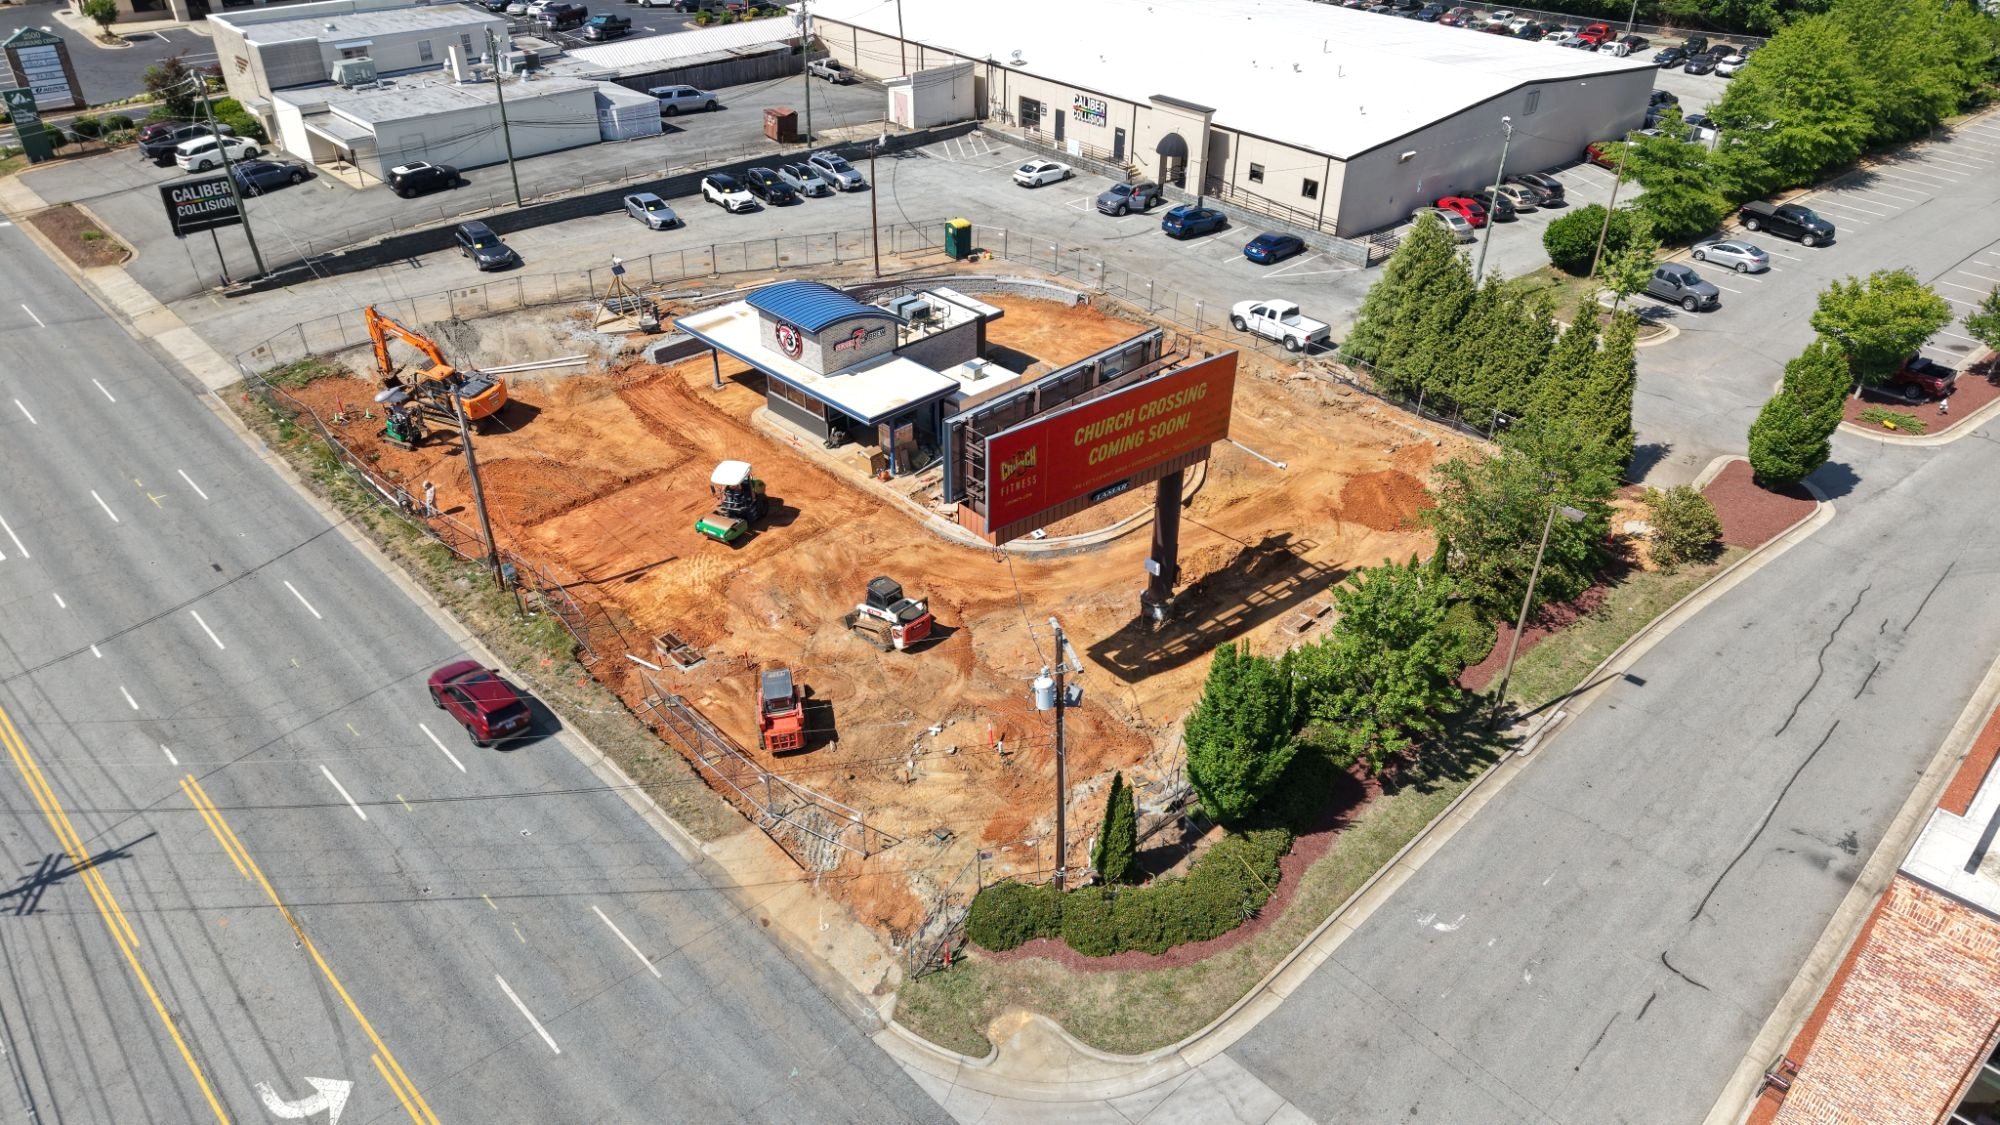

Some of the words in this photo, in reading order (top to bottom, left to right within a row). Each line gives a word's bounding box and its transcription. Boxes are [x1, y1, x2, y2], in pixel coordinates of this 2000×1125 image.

[1072, 94, 1107, 113] CALIBER
[1072, 109, 1106, 128] COLLISION
[171, 181, 232, 203] CALIBER
[177, 196, 237, 217] COLLISION
[868, 327, 886, 341] BREW
[1074, 408, 1136, 447] CHURCH
[1138, 382, 1208, 423] CROSSING
[1088, 430, 1145, 466] COMING
[1148, 411, 1192, 442] SOON!
[1001, 474, 1037, 497] FITNESS
